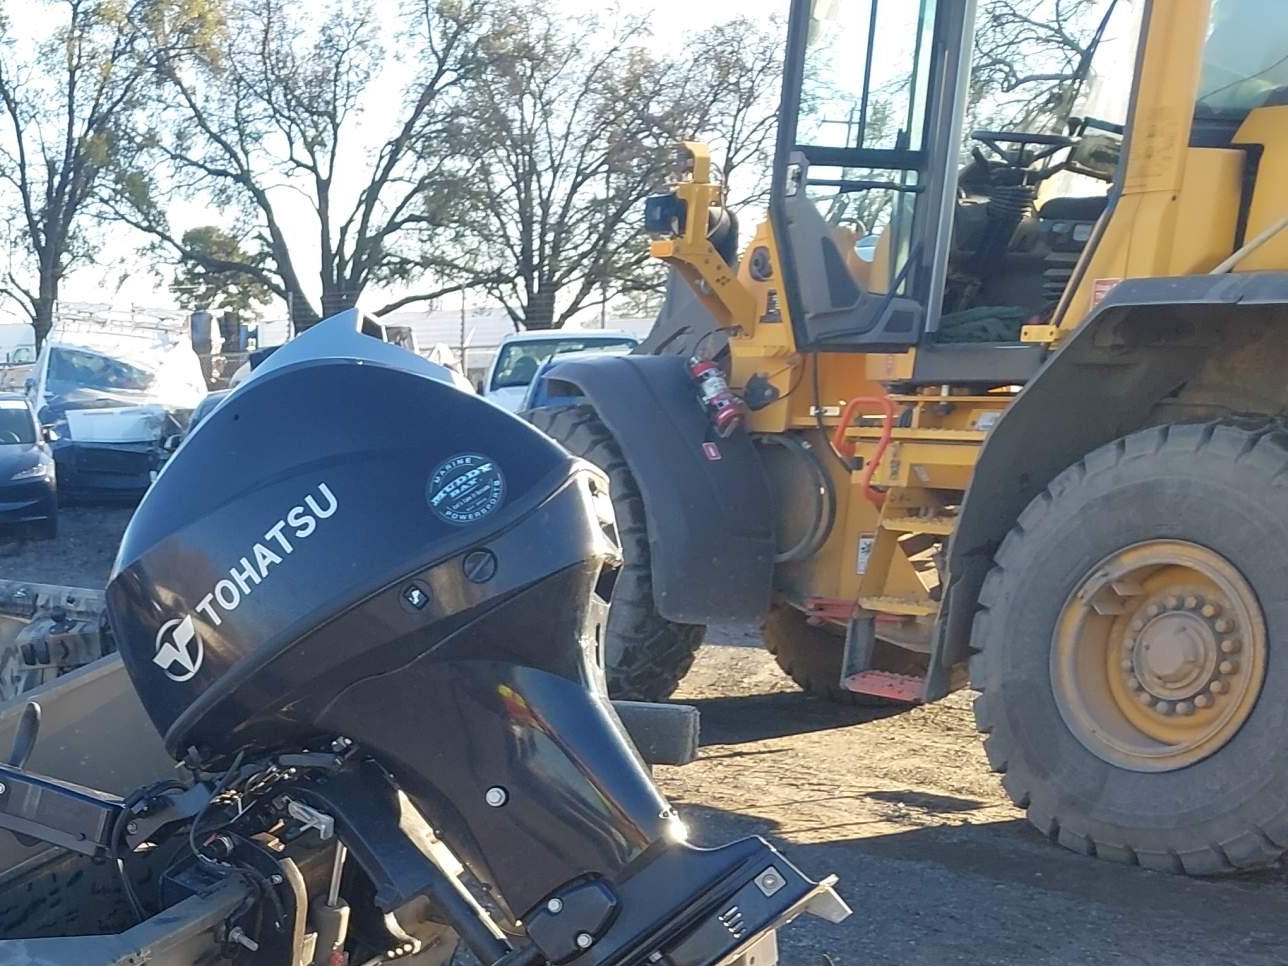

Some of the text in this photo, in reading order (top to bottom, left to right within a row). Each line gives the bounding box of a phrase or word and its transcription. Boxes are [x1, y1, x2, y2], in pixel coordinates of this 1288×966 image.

[431, 462, 493, 507] MUDDY
[434, 457, 472, 484] MARINE
[449, 477, 478, 498] BAY
[444, 479, 501, 520] POWERSPORTS
[195, 482, 338, 626] TOHATSU
